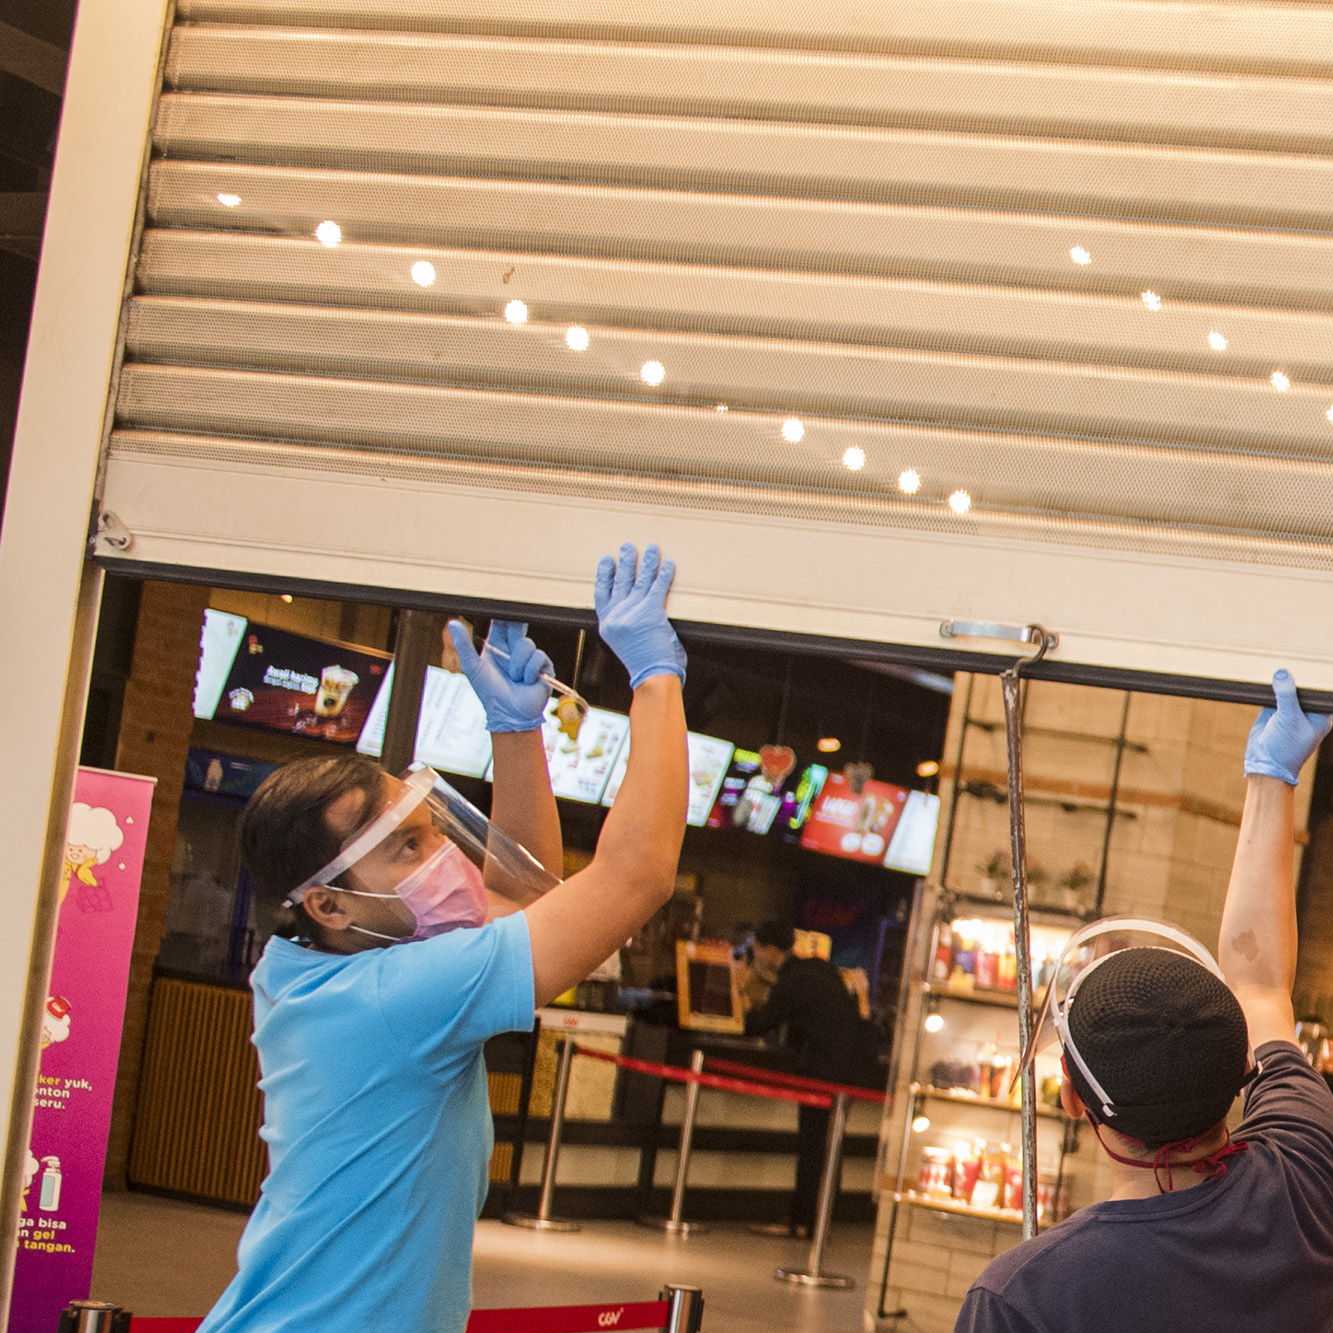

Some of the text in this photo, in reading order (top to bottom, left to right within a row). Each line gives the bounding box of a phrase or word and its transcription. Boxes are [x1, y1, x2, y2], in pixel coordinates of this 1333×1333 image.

[38, 1074, 93, 1092] ker yuk,
[18, 1217, 67, 1230] ga bisa
[33, 1230, 55, 1241] gel
[24, 1240, 75, 1253] tangan.
